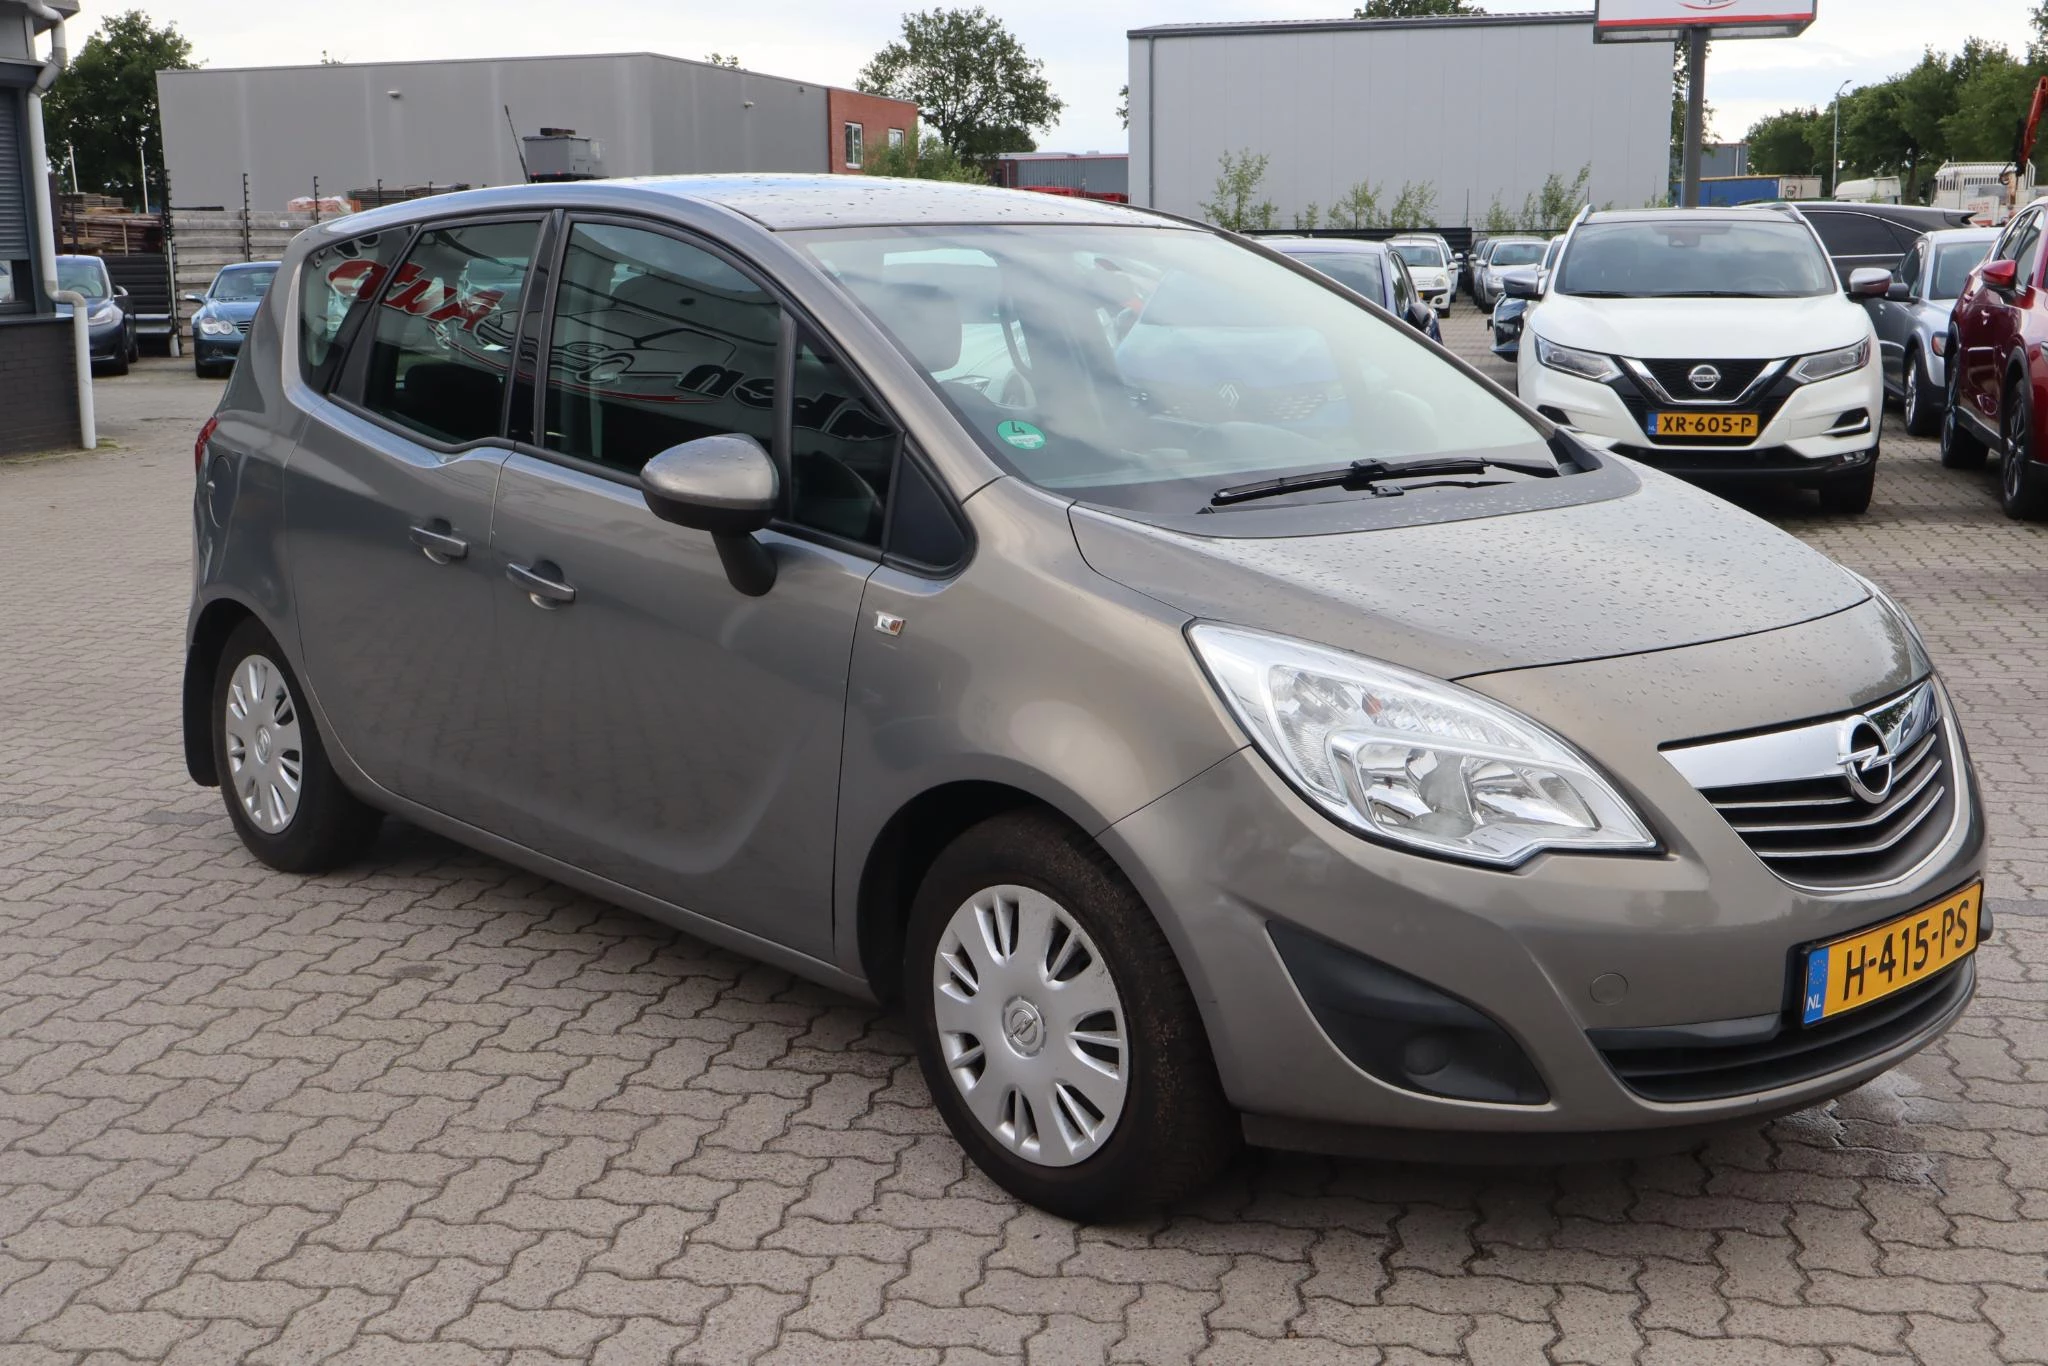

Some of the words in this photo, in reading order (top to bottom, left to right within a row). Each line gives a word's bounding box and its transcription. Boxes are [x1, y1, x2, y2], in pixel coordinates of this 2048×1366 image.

[1010, 421, 1025, 434] 4
[1663, 416, 1752, 433] XR-605-P
[1843, 900, 1969, 1001] H-415-PS
[1806, 993, 1822, 1012] NL
